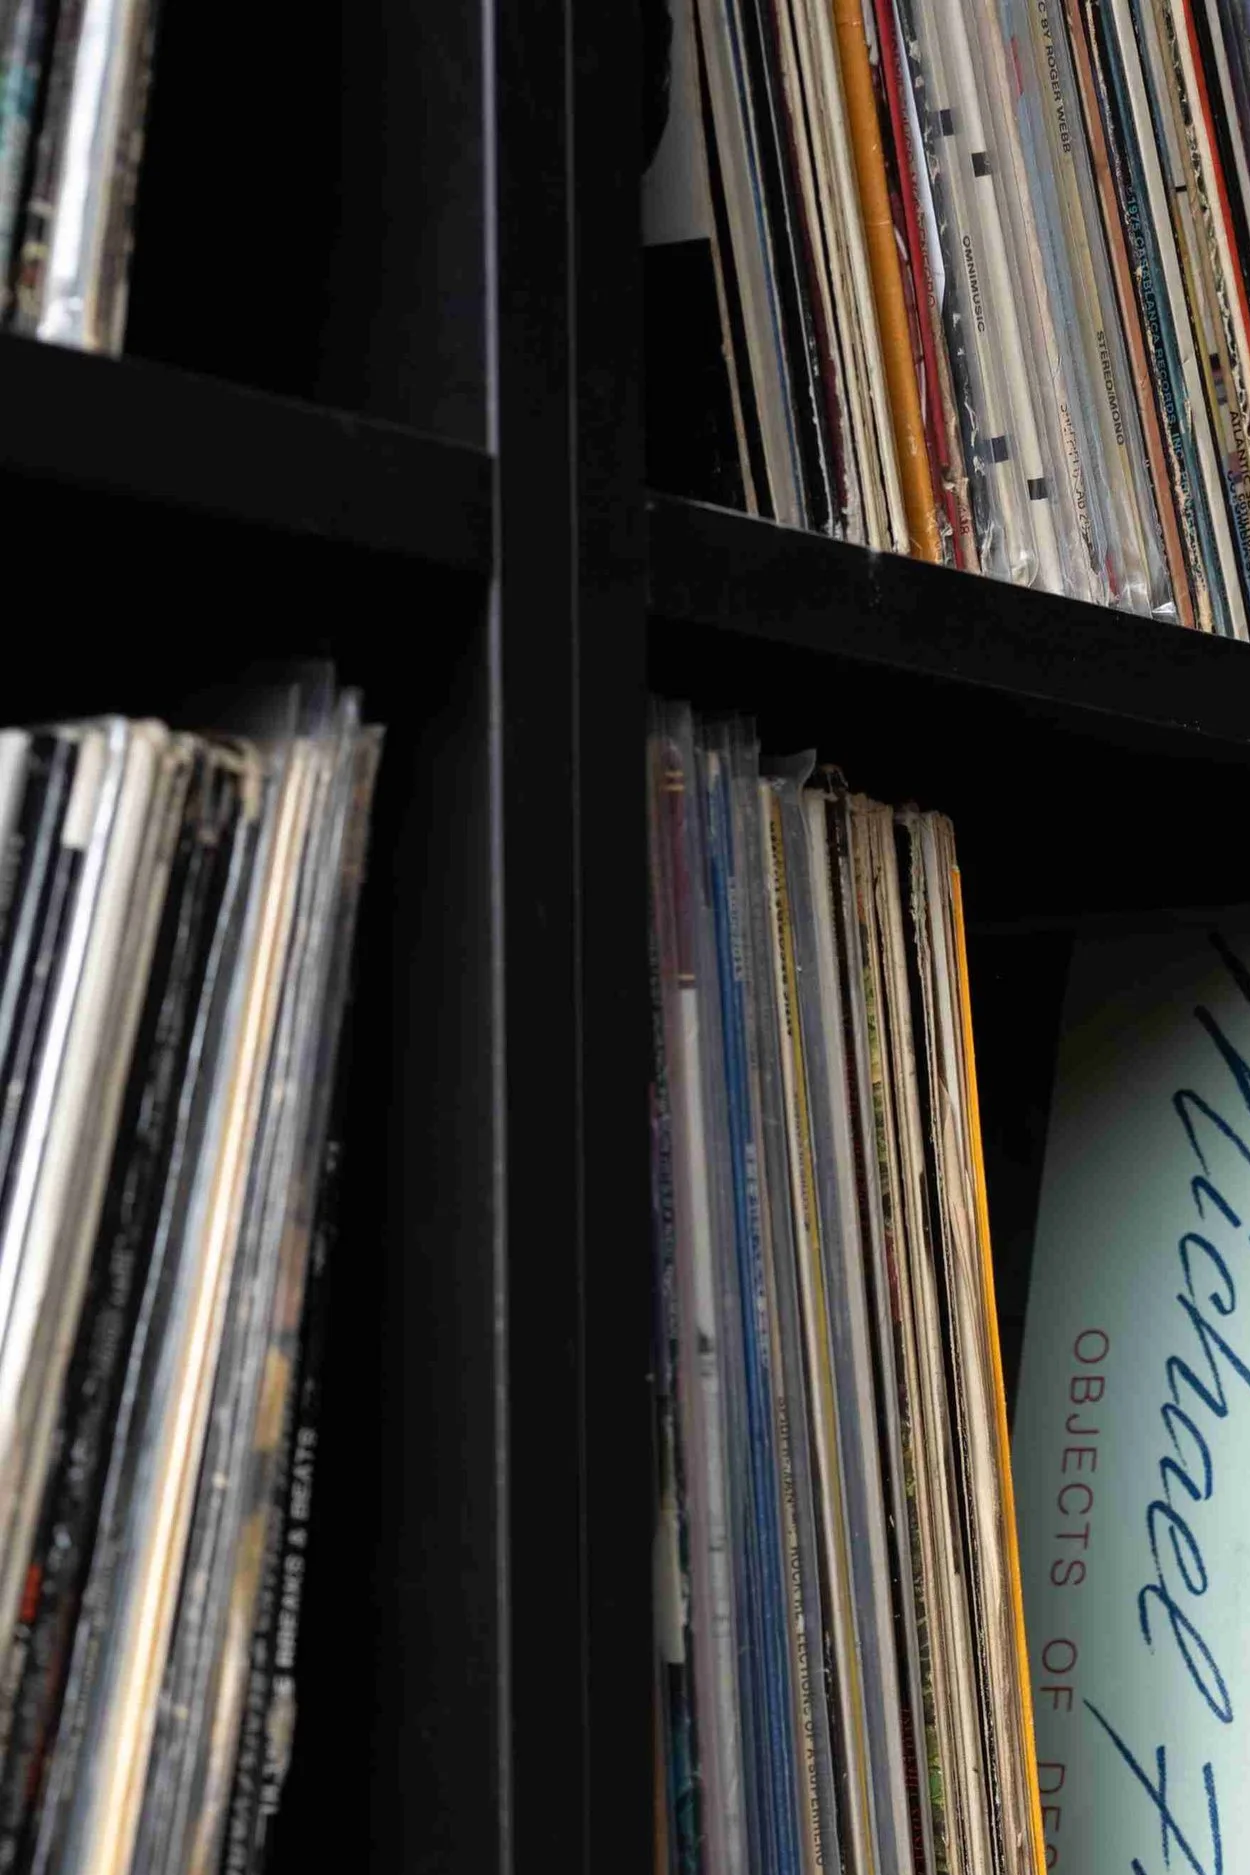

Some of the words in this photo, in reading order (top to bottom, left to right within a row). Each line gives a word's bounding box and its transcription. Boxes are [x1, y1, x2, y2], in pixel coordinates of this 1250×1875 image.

[1040, 17, 1050, 38] BY
[1044, 44, 1061, 102] ROGER
[1056, 105, 1070, 153] WEBB
[1126, 197, 1142, 231] 1975
[959, 235, 988, 333] OMNIMUSIC
[1131, 235, 1163, 344] CASABLANCA
[1094, 330, 1126, 446] STEREO/MONO
[1048, 1328, 1110, 1588] OBJECTS
[1037, 1638, 1081, 1712] OF
